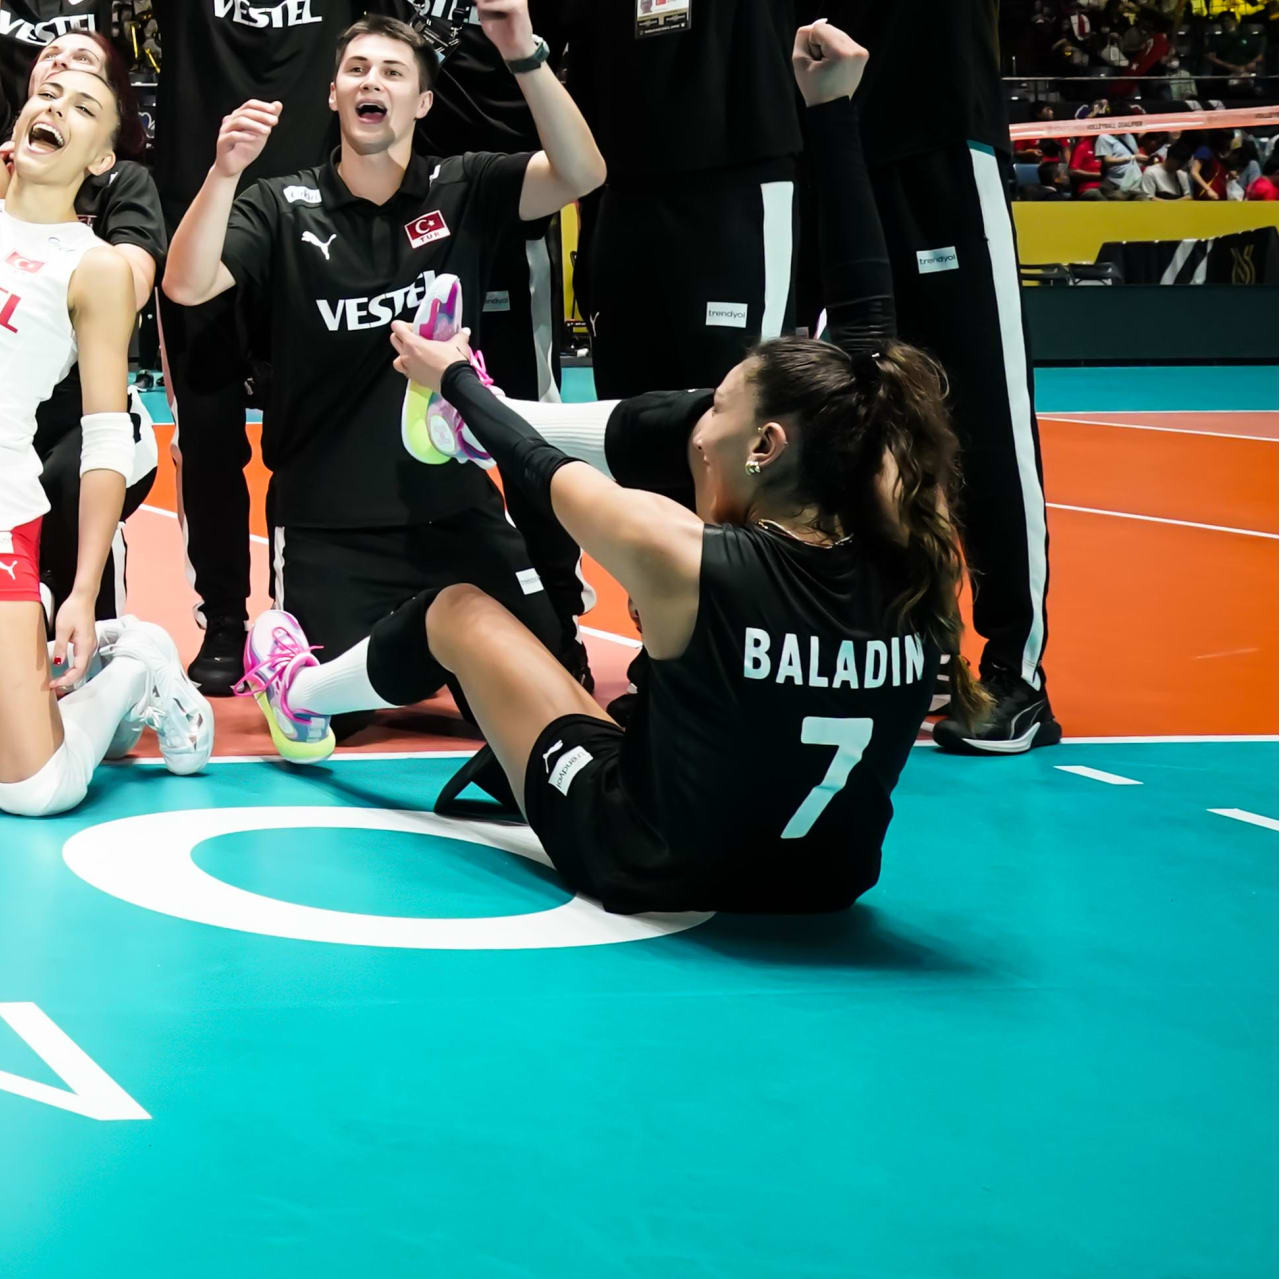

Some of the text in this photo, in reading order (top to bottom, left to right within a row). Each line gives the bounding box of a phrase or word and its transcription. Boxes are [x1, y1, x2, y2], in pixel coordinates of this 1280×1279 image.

[420, 231, 440, 242] TUR
[919, 252, 956, 266] trendyol
[708, 309, 746, 320] trendyol
[743, 626, 925, 690] BALADIN
[780, 715, 875, 840] 7
